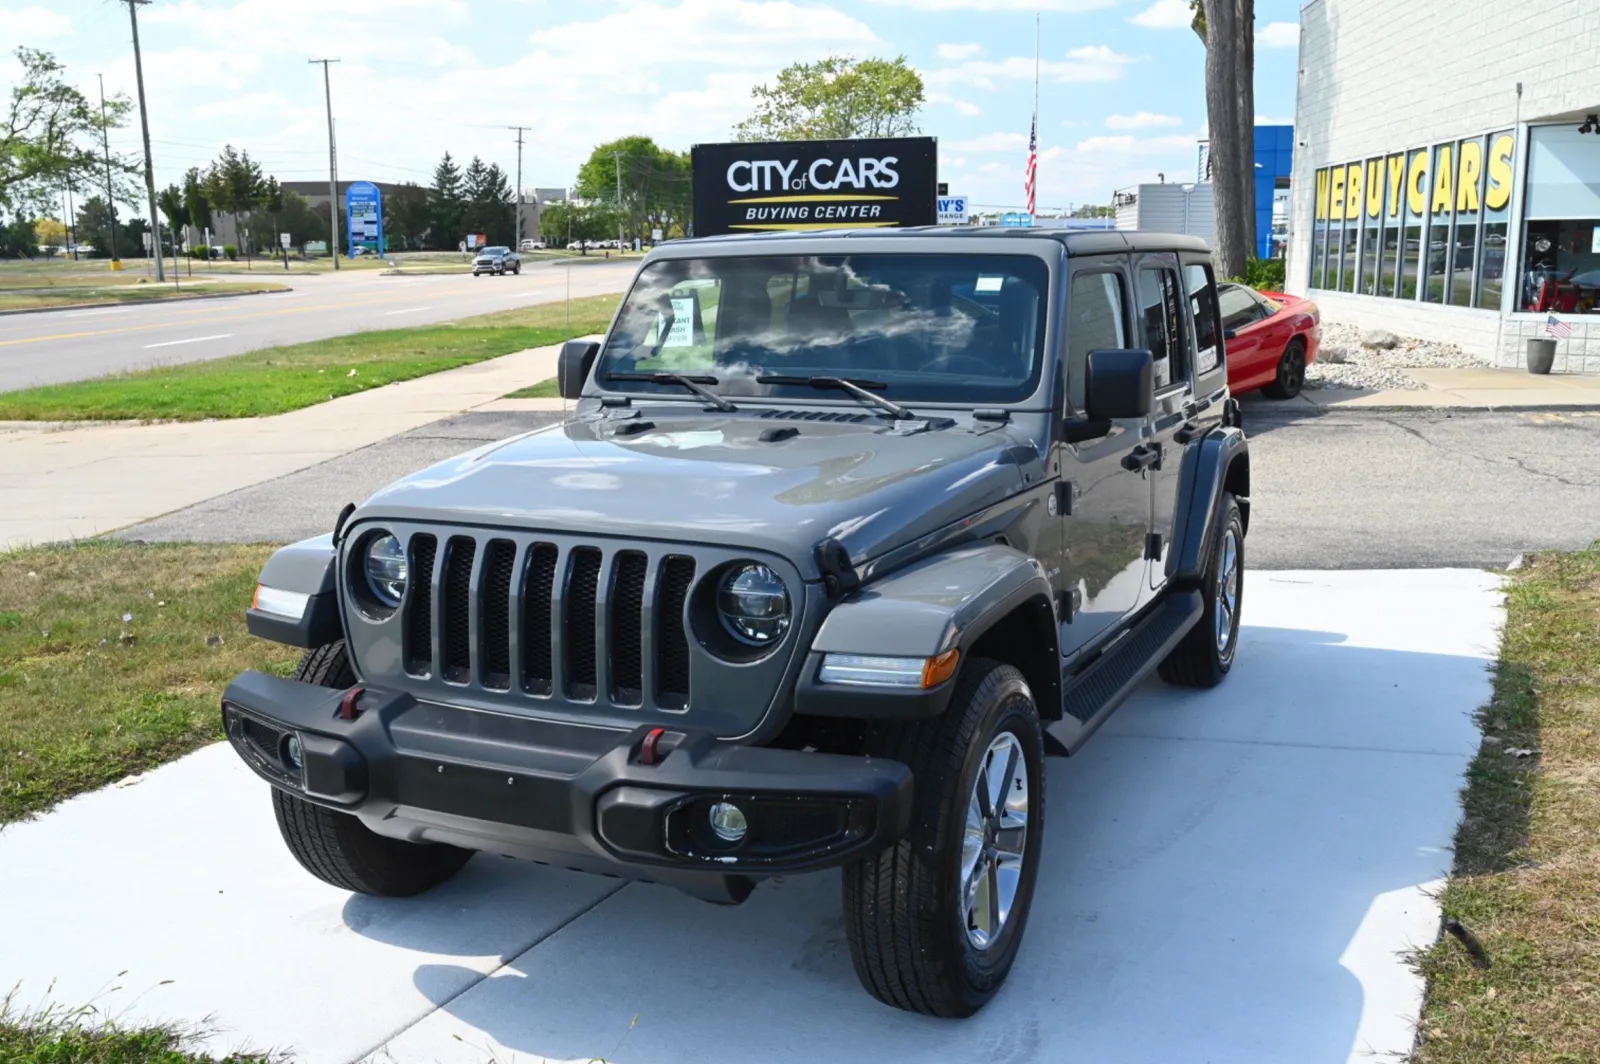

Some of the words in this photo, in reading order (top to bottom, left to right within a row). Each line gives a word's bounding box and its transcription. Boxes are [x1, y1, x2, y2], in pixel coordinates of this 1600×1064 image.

[726, 158, 799, 192] CITY
[791, 173, 807, 190] of
[808, 156, 900, 190] CARS
[745, 204, 809, 220] BUYING
[814, 204, 882, 219] CENTER
